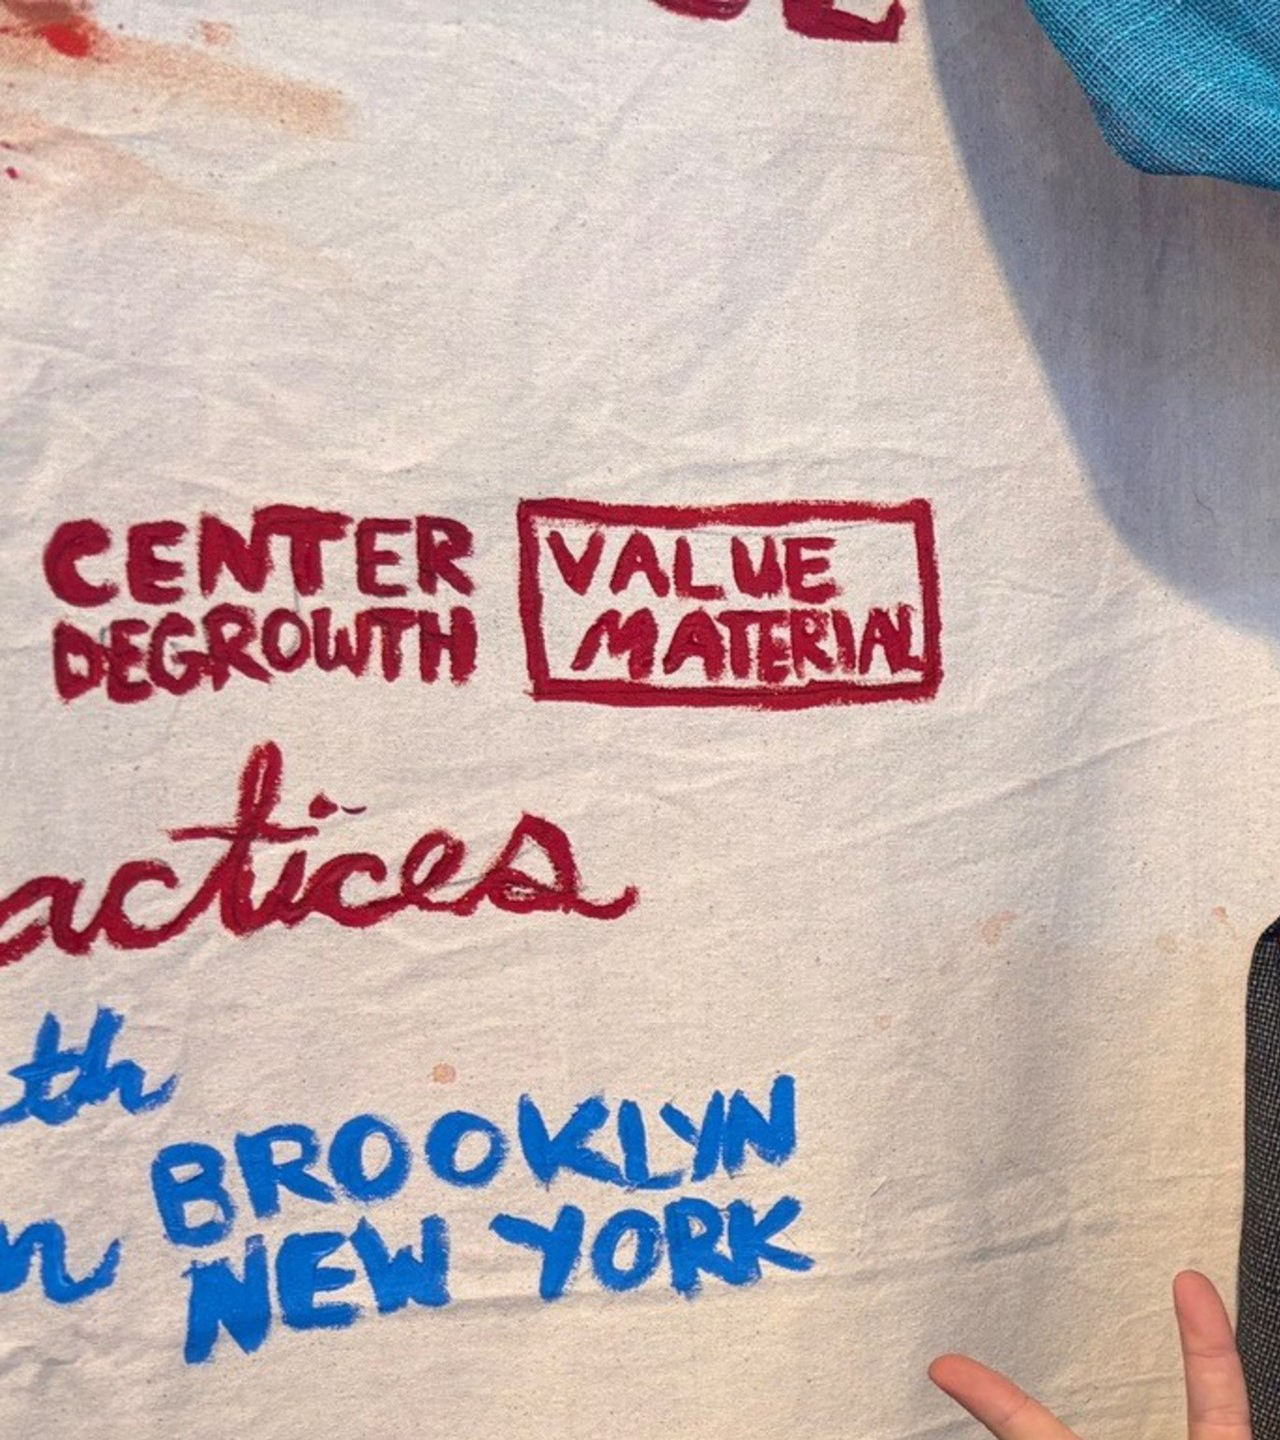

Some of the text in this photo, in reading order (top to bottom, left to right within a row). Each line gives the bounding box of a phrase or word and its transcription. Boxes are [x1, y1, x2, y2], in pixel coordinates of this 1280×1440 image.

[43, 504, 475, 607] CENTER
[546, 530, 843, 605] VALUE
[53, 602, 478, 704] DEGROWTH
[571, 607, 927, 684] MATERIAL
[151, 1074, 797, 1248] BROOKLYN
[183, 1197, 814, 1365] NEW YORK
